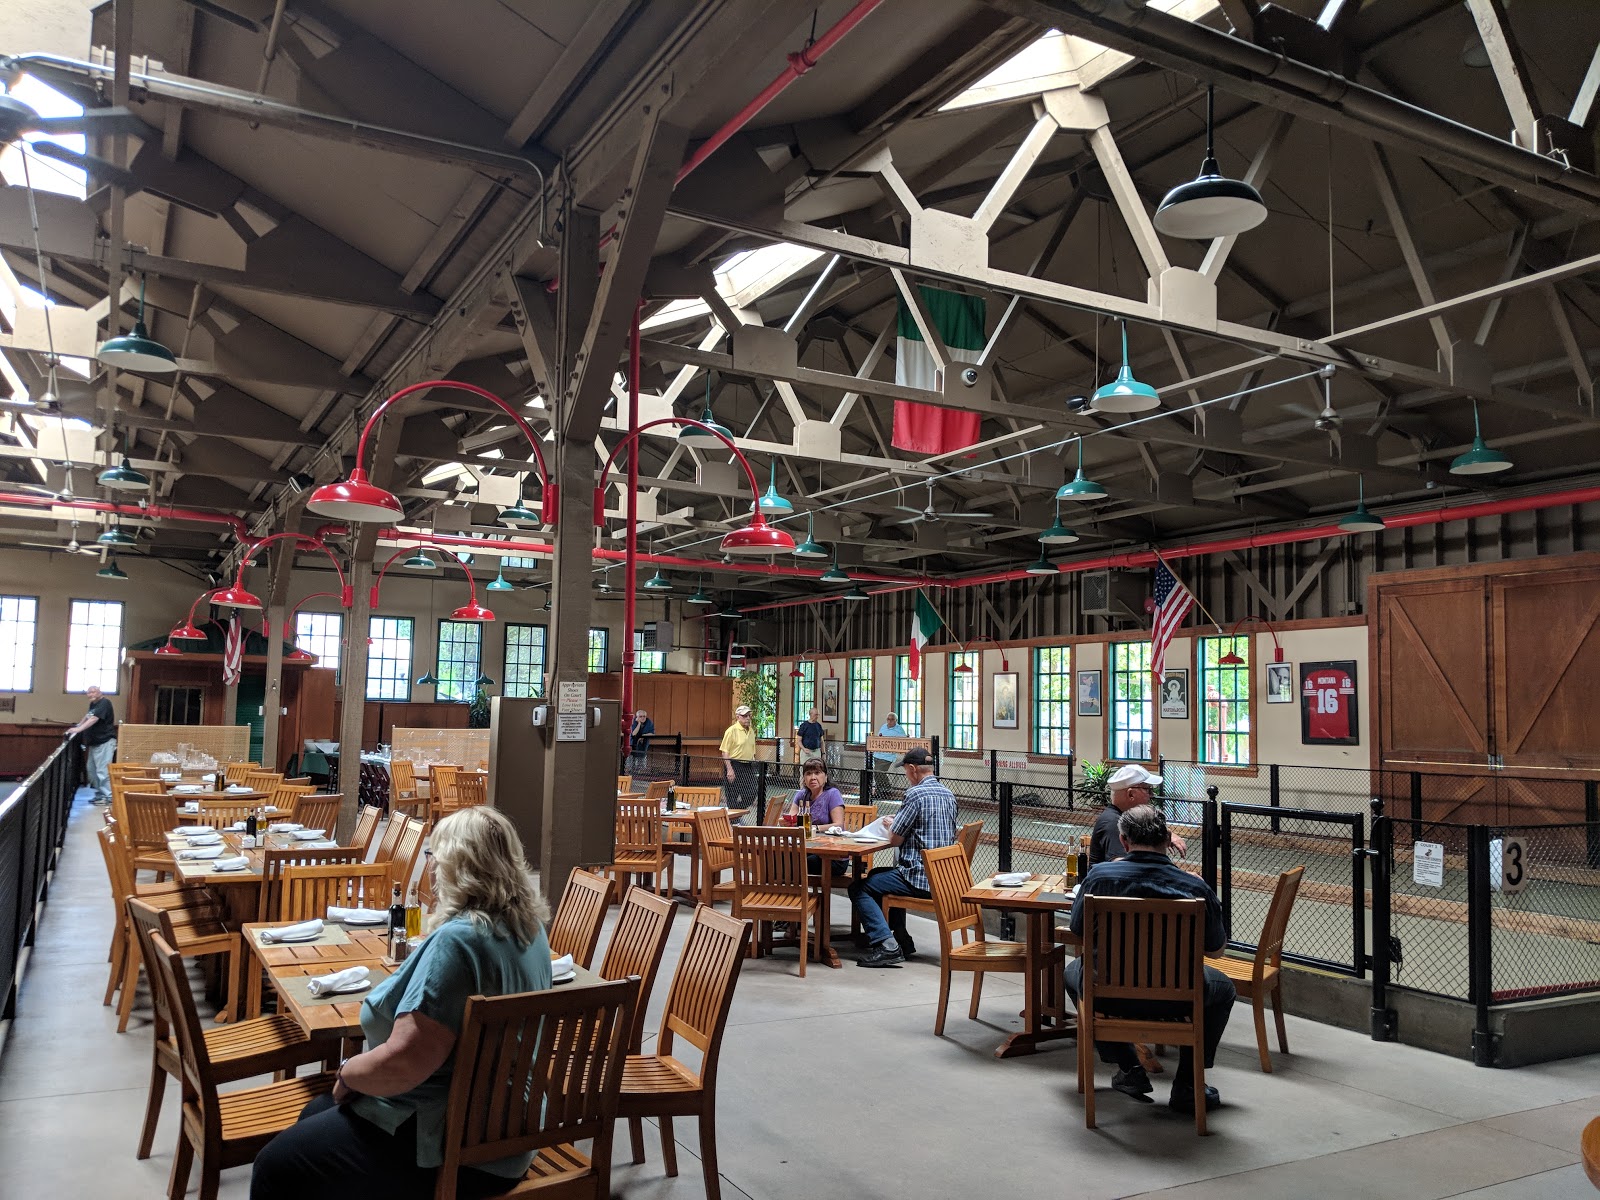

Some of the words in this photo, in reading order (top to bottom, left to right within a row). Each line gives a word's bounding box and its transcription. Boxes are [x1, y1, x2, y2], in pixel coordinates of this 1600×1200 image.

[1305, 680, 1313, 689] 16
[1342, 678, 1351, 688] 16
[1317, 688, 1339, 714] 16
[1506, 841, 1523, 886] 3
